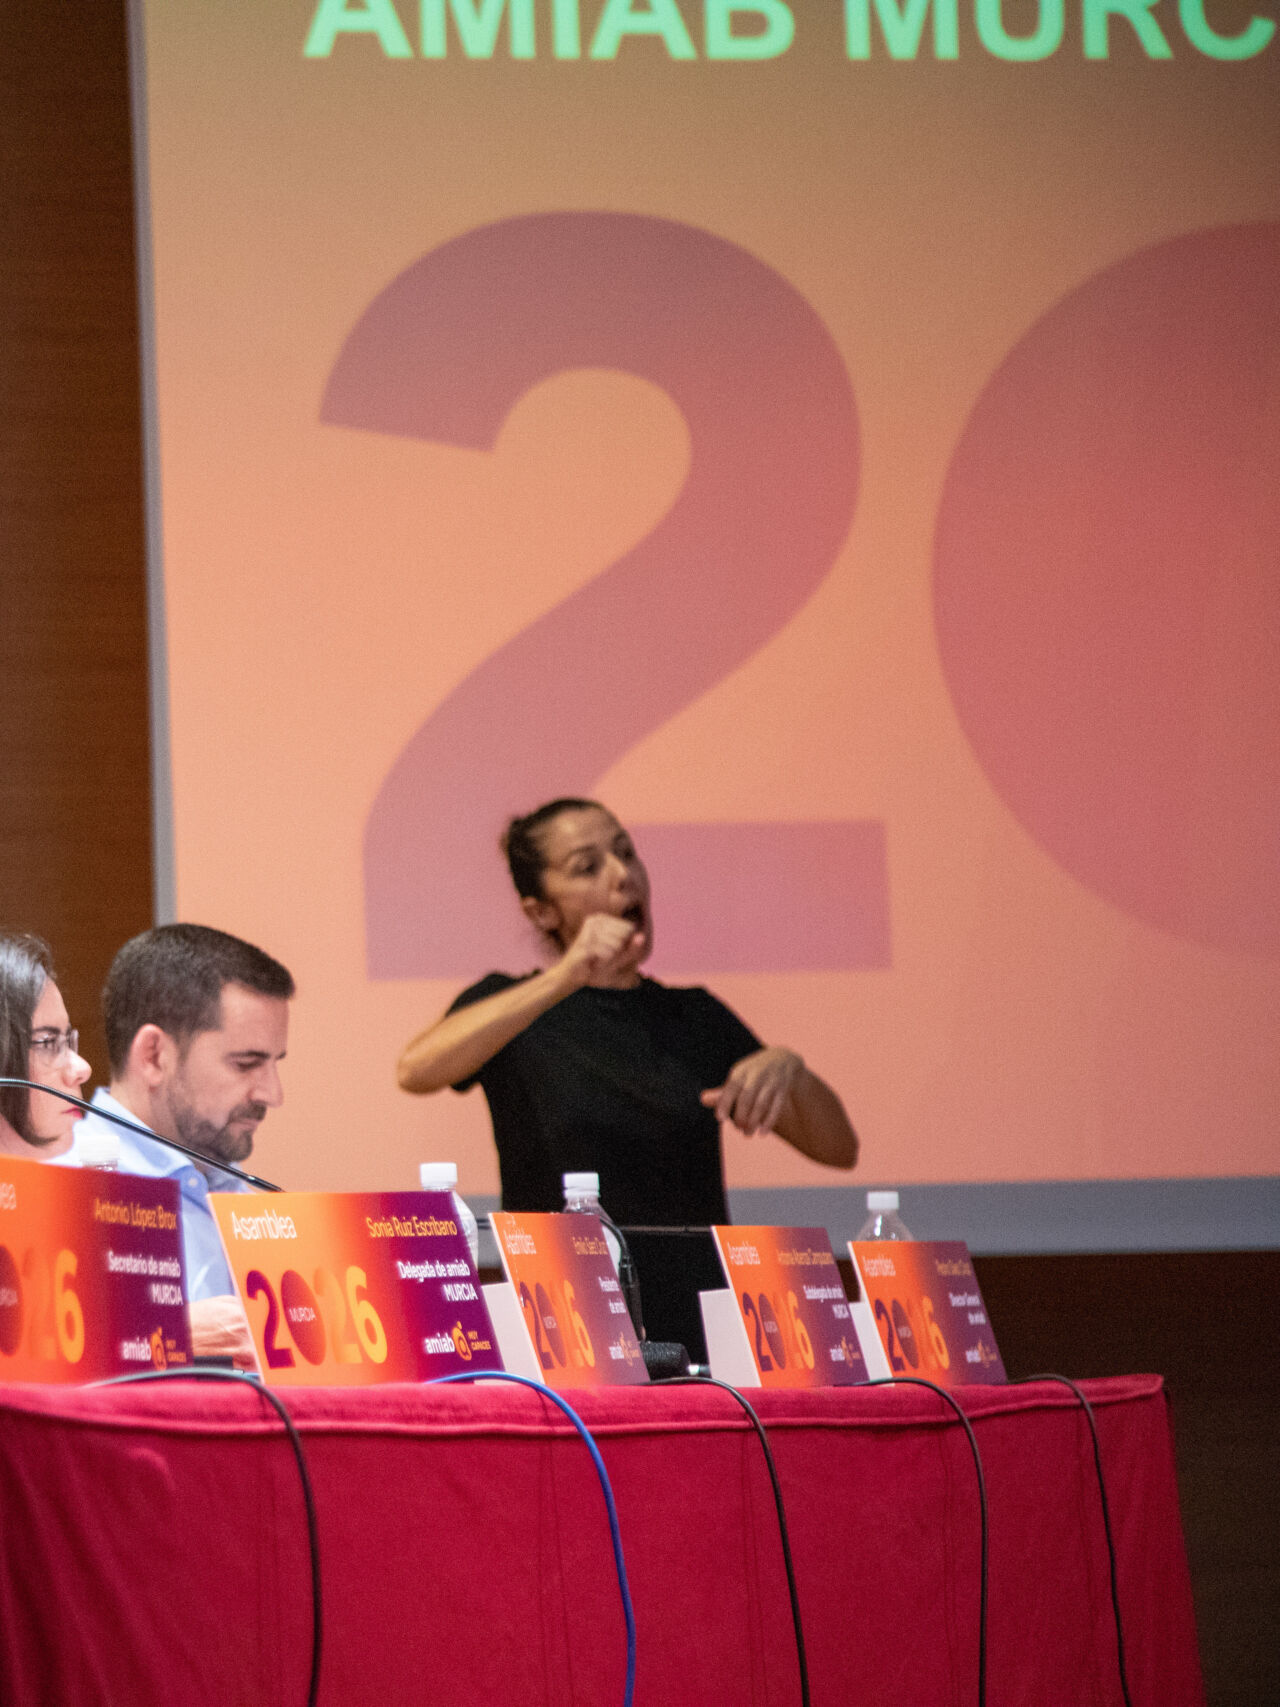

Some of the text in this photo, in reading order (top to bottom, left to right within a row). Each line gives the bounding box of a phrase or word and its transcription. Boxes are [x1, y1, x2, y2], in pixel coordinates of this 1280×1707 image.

[303, 0, 1277, 61] AMIAB MURC
[95, 1198, 130, 1225] Antonio
[130, 1202, 157, 1232] López
[232, 1209, 297, 1240] Asamblea
[366, 1216, 458, 1237] Sonia Ruiz Escribano
[108, 1251, 181, 1278] Secretario de amiab
[397, 1259, 471, 1283] Delegada de amiab
[151, 1283, 184, 1306] MURCIA
[442, 1283, 479, 1301] MURCIA
[289, 1307, 317, 1323] MURCIA
[122, 1336, 152, 1361] amiab
[424, 1331, 456, 1355] amiab
